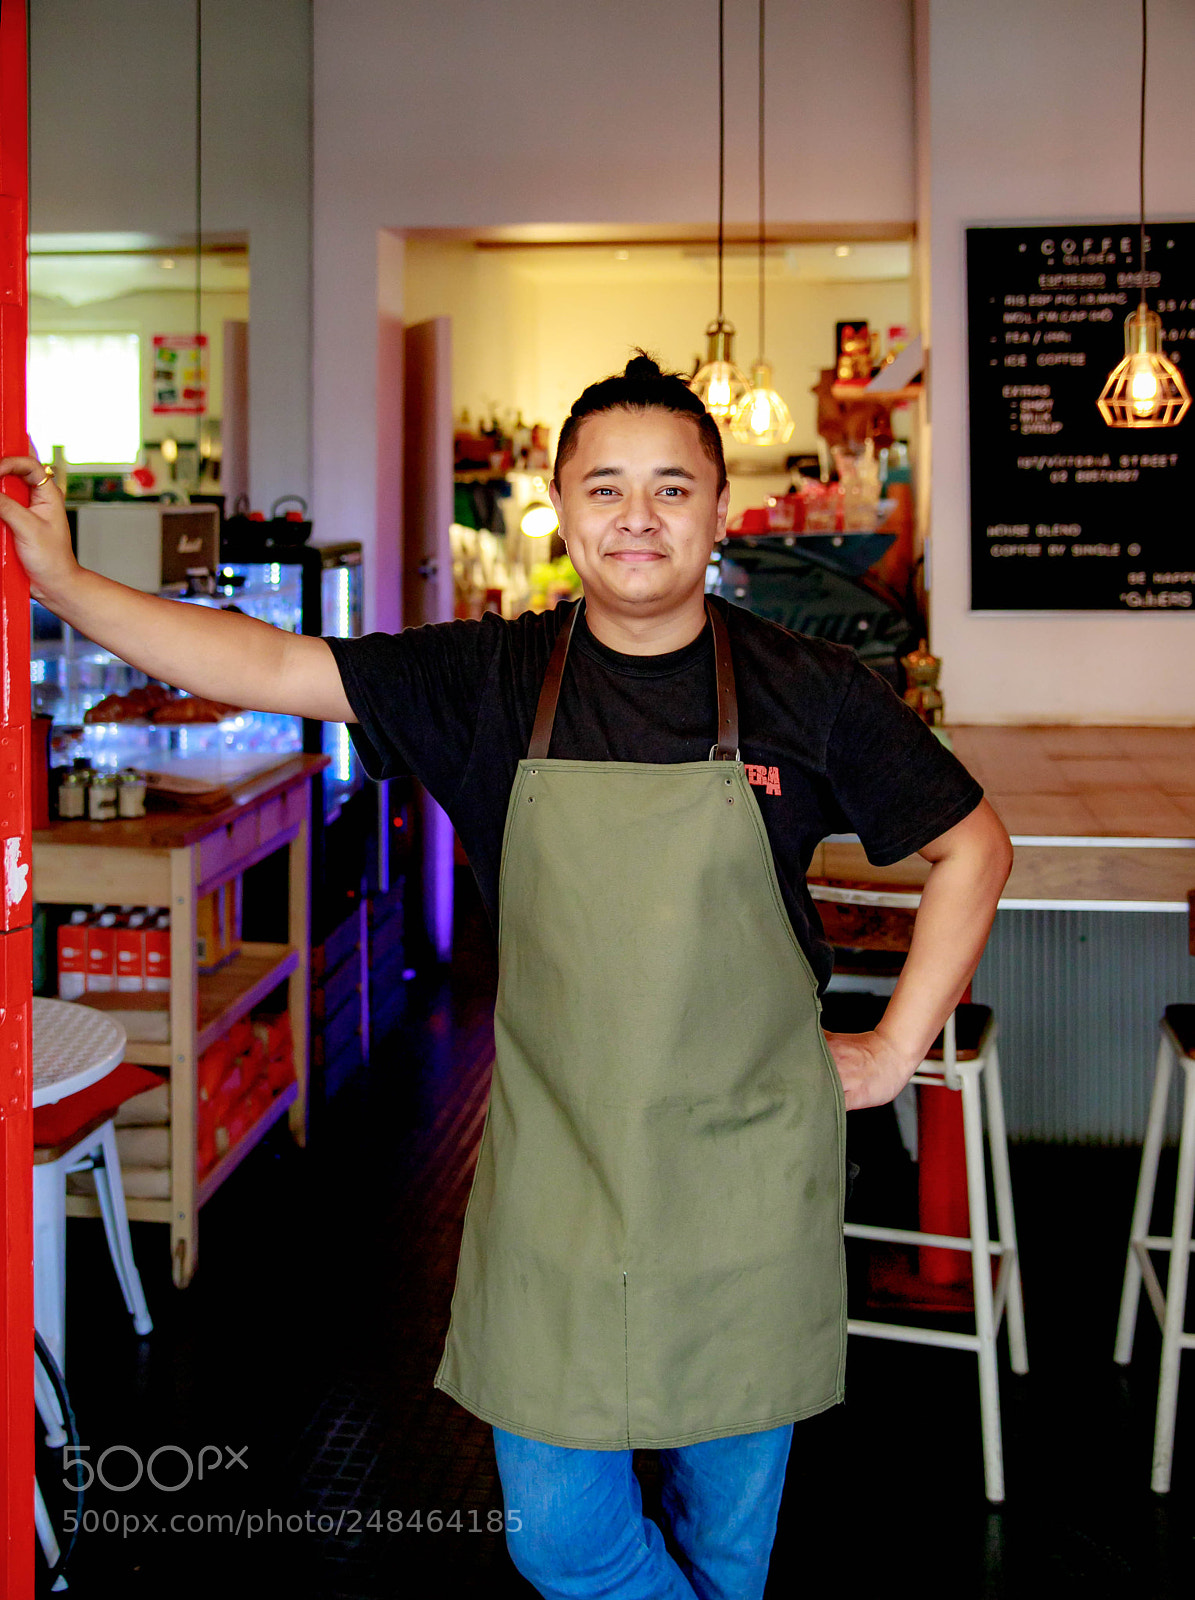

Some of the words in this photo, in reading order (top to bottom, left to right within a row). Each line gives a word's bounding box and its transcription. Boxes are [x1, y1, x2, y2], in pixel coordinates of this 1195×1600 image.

[1038, 273, 1106, 288] ESPRESSO
[1117, 271, 1161, 287] BASED
[1004, 353, 1027, 367] ICE
[1037, 352, 1086, 366] COFFEE
[1119, 454, 1178, 468] STREET
[987, 523, 1030, 537] HOUSE
[1035, 523, 1082, 537] BLEND
[990, 544, 1042, 557] COFFEE
